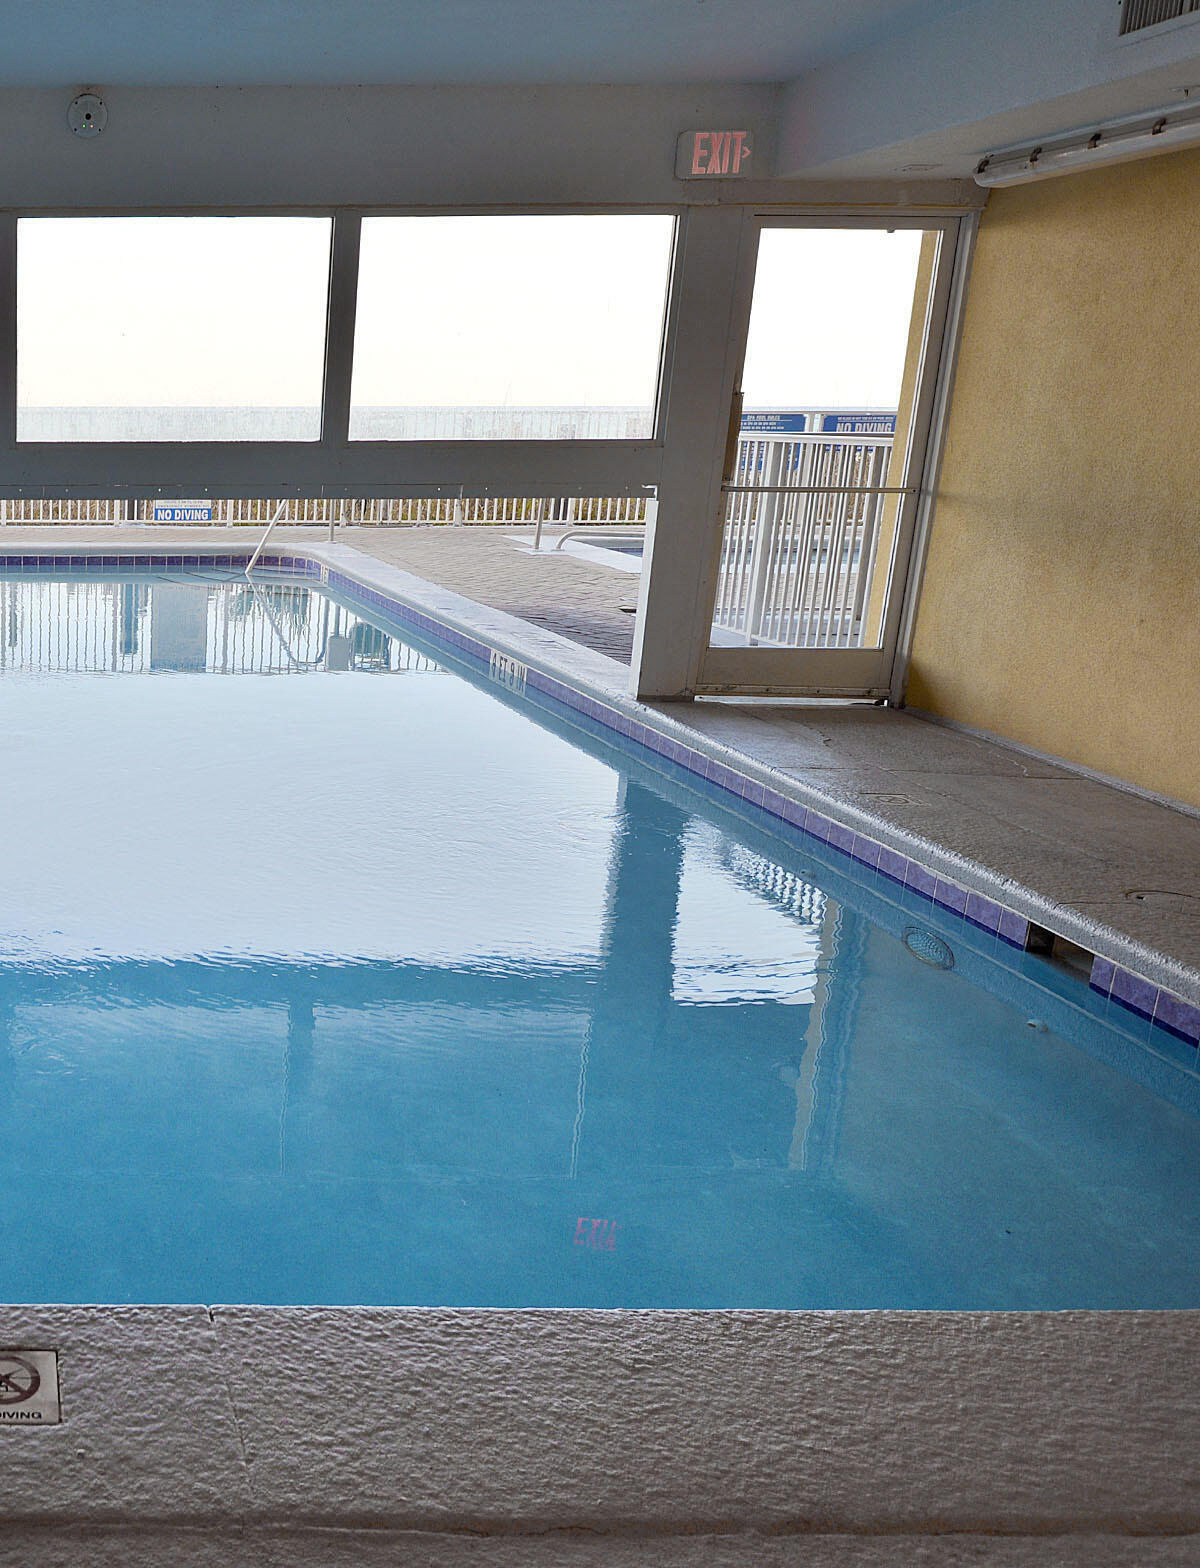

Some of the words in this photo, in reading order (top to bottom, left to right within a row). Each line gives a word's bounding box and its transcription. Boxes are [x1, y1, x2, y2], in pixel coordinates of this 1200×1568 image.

[692, 132, 747, 174] EXIT
[836, 422, 852, 433] NO
[855, 422, 892, 433] DIVING
[157, 509, 172, 520] NO
[174, 509, 209, 520] DIVING
